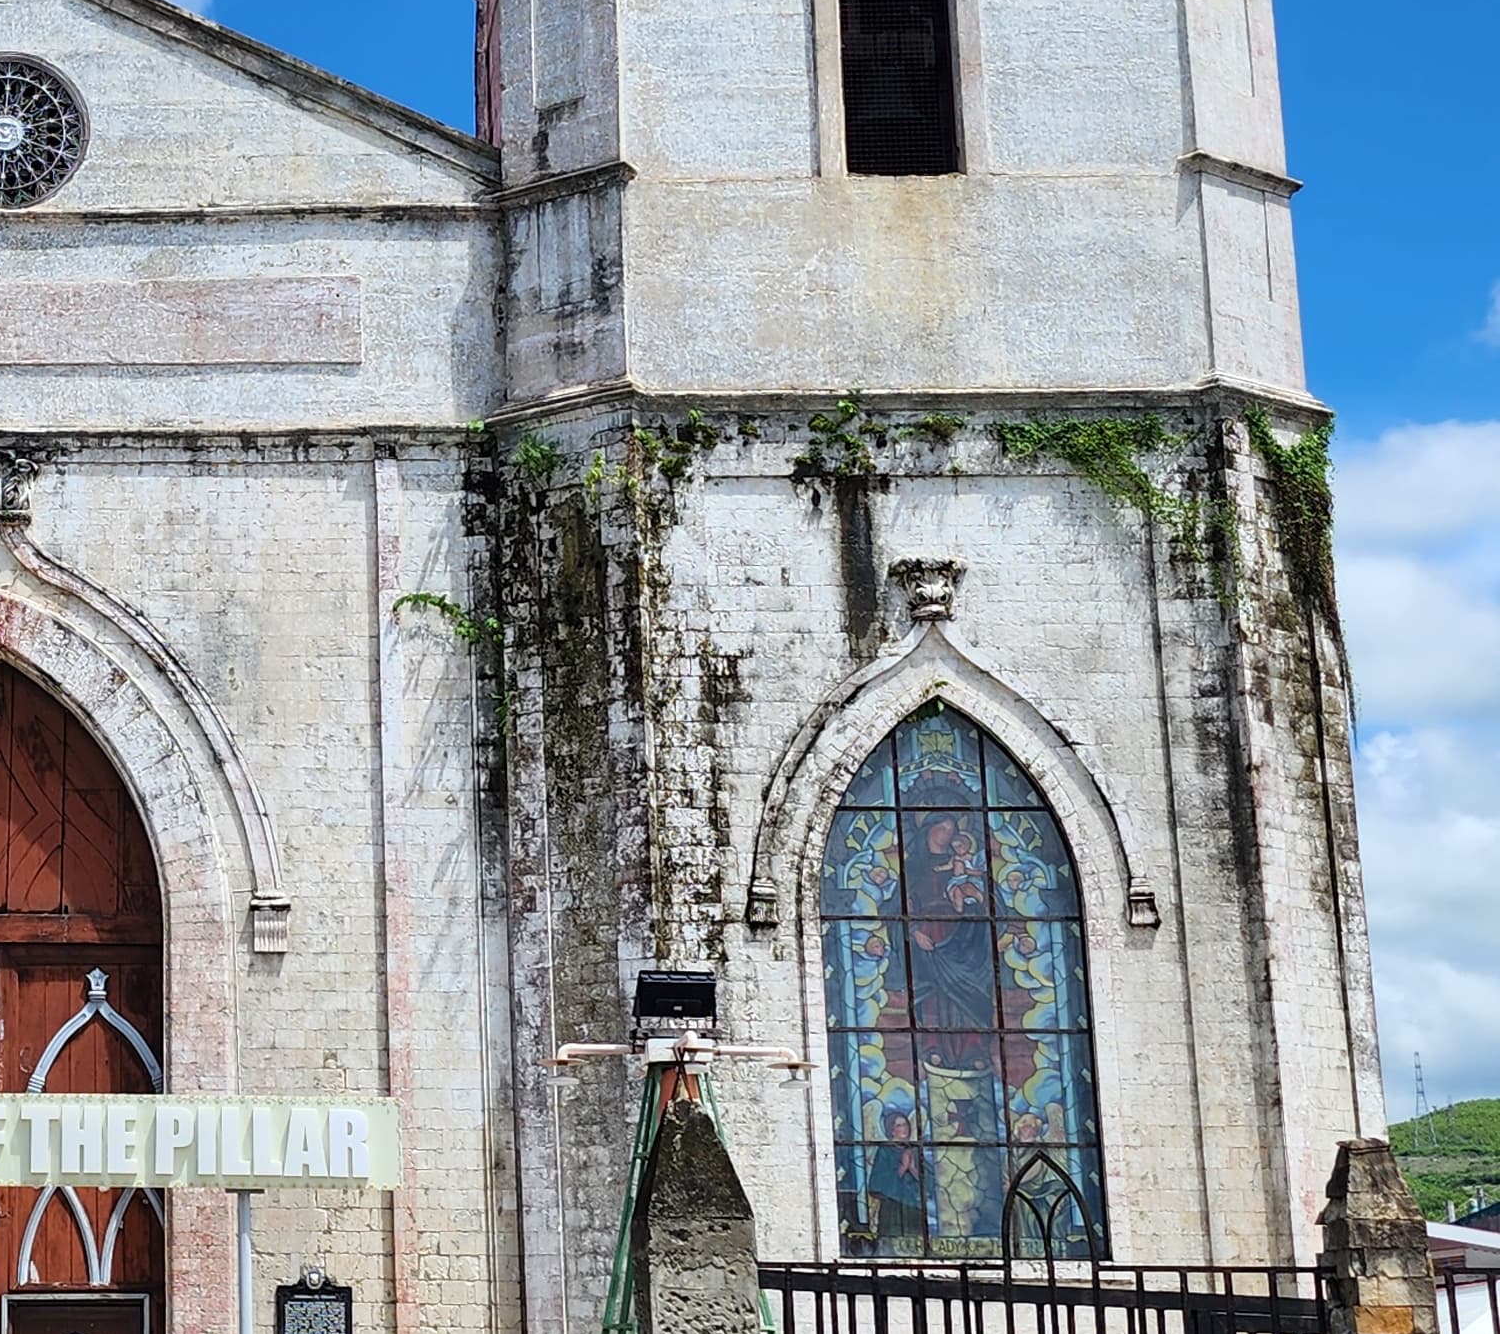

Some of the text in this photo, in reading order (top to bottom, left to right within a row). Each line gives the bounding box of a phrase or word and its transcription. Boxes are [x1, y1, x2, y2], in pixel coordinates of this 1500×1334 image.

[21, 1105, 138, 1174] THE
[154, 1106, 370, 1178] PILLAR
[931, 1239, 963, 1253] LADY
